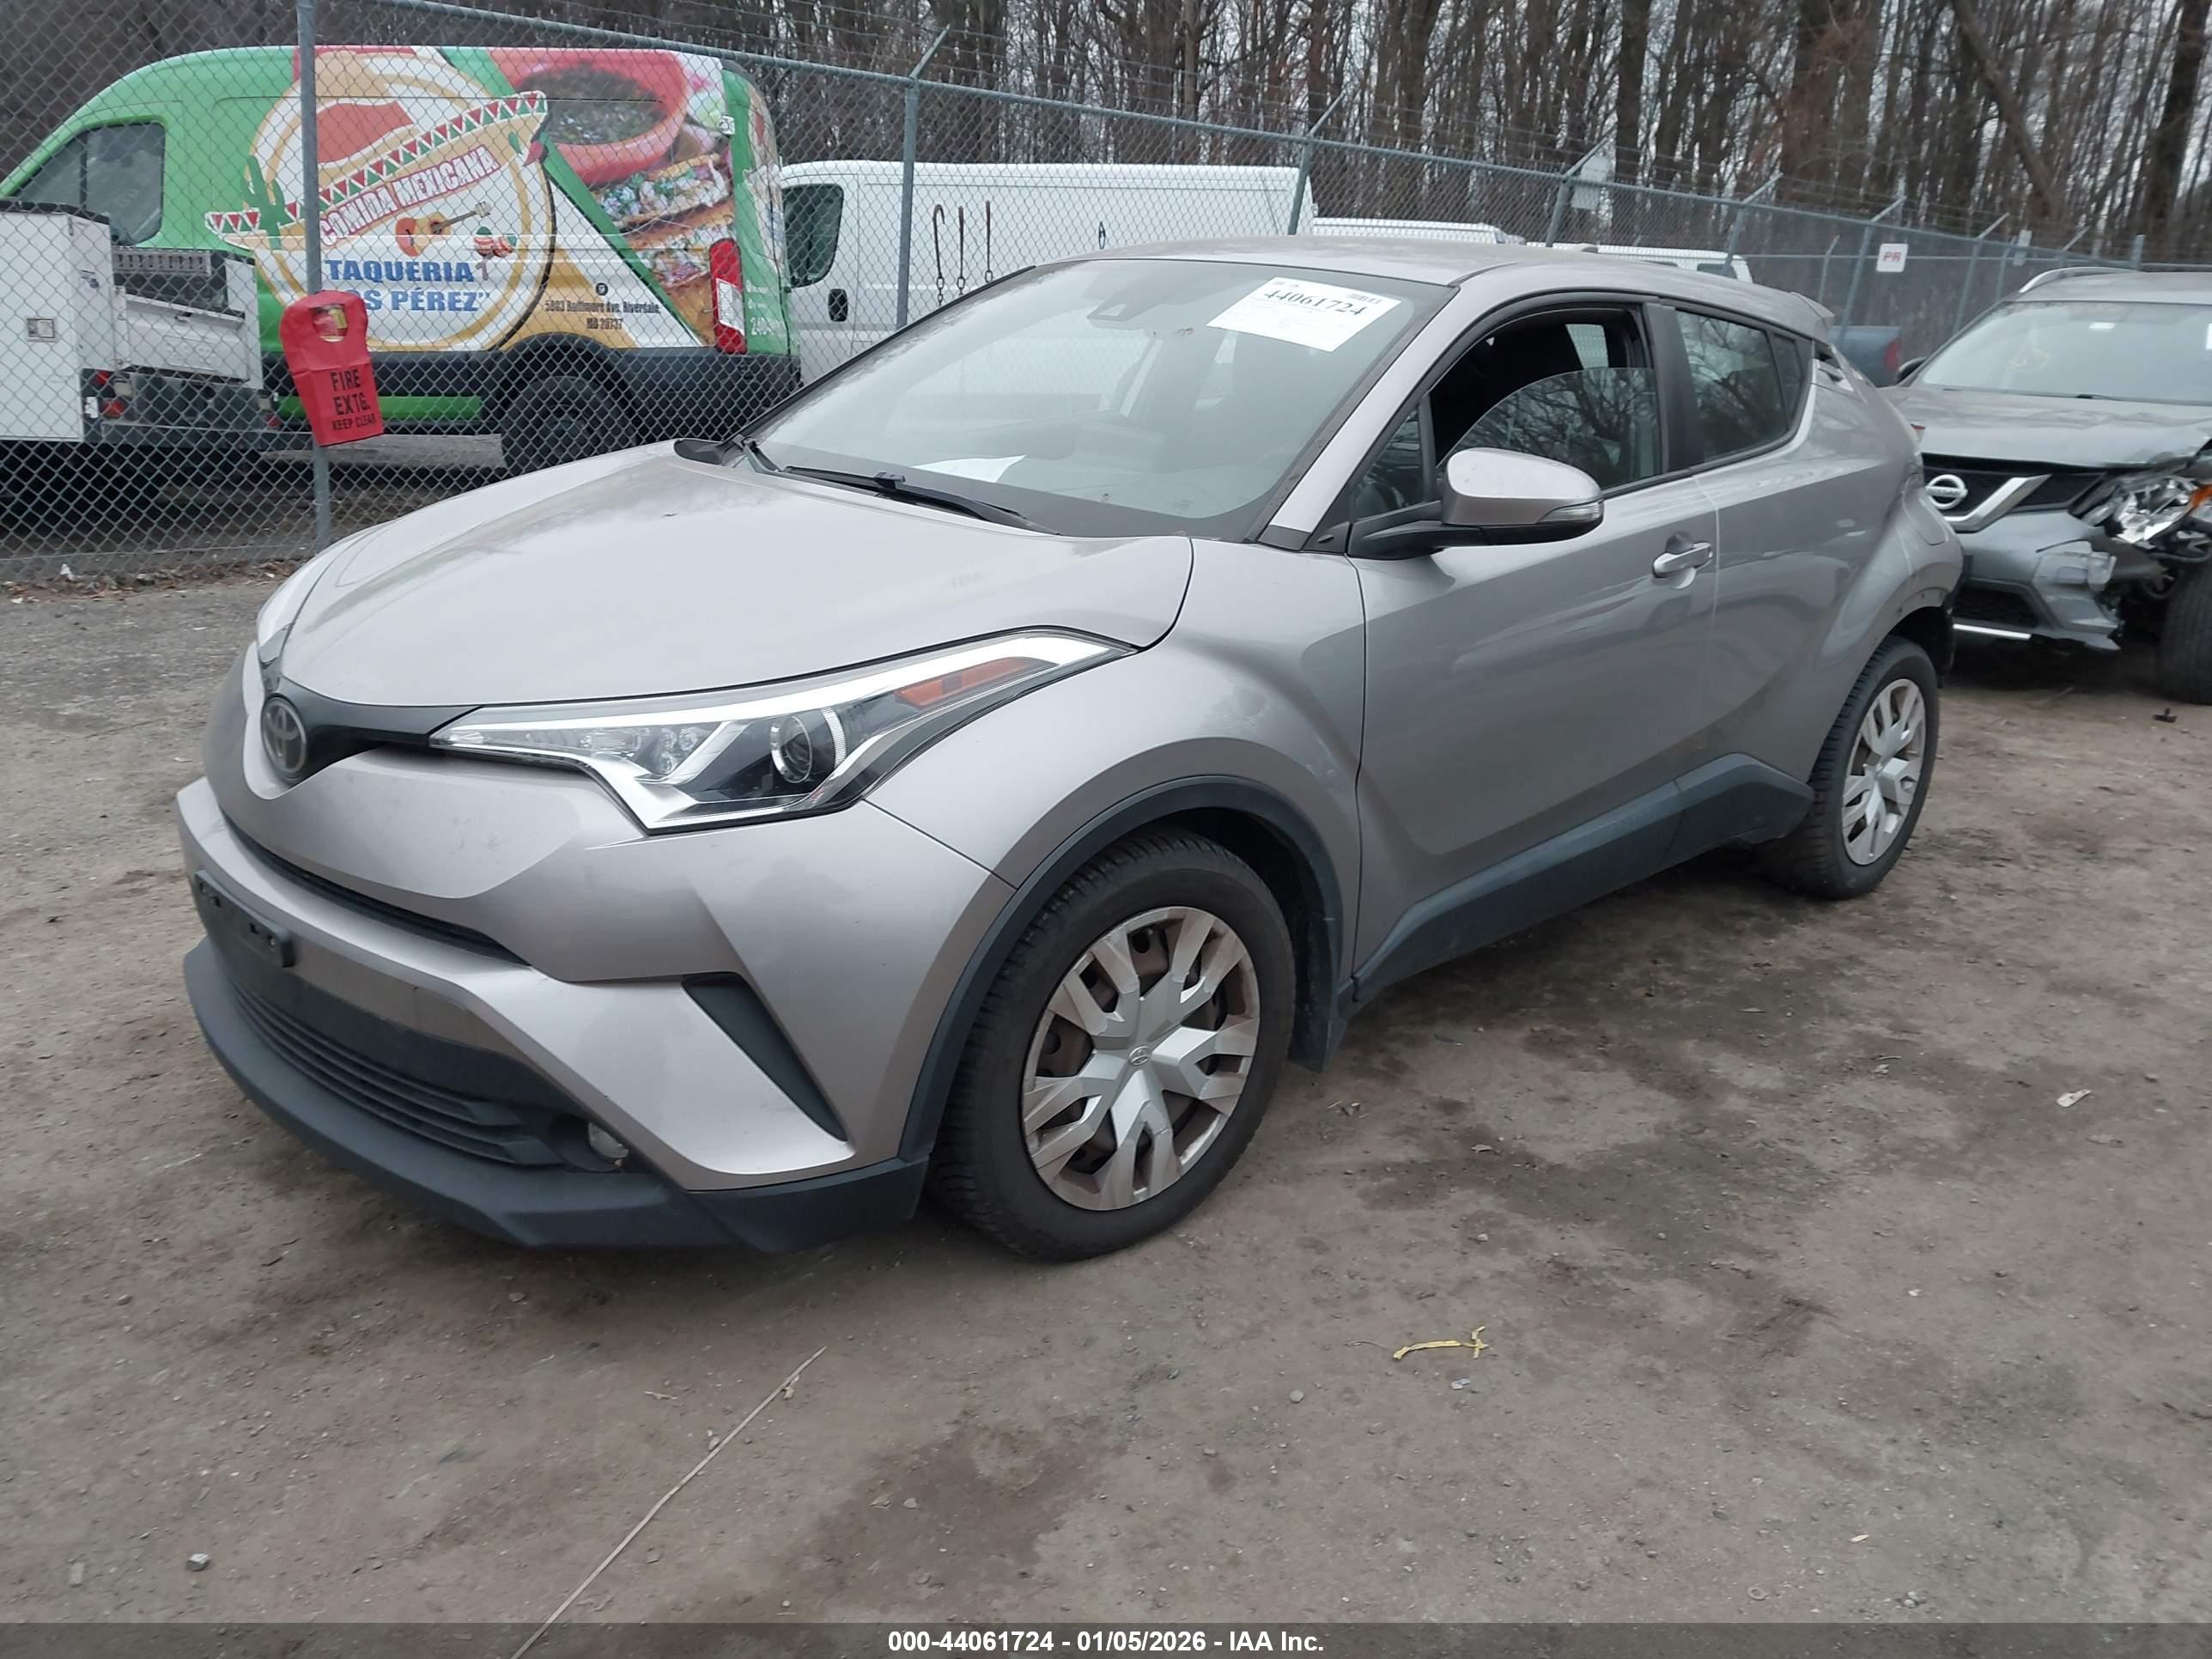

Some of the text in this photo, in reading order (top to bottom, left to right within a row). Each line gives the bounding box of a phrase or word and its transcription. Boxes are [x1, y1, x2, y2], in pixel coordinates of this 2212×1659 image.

[319, 144, 501, 246] COMIDA MEXICANA
[325, 259, 475, 283] TAQUERIA
[1264, 290, 1368, 315] 44061724
[331, 369, 361, 392] FIRE
[333, 392, 371, 416] EXTG.
[332, 414, 375, 431] KEEP CLEAR
